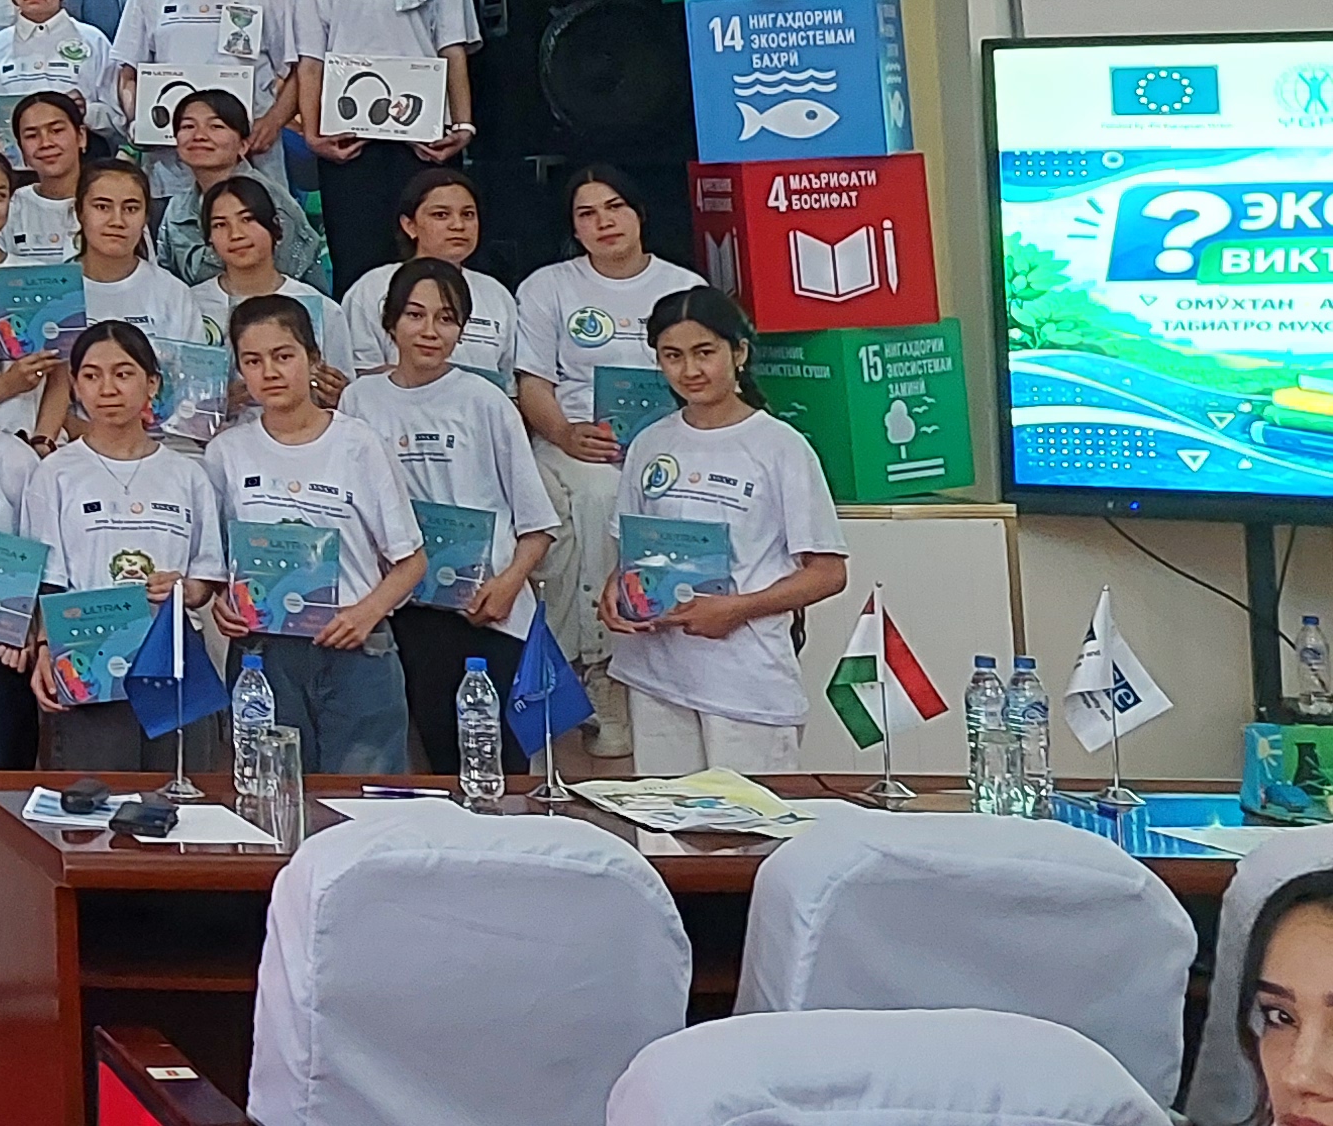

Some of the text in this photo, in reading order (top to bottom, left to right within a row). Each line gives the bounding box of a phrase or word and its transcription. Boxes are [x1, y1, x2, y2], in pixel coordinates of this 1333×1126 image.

[708, 15, 744, 53] 14
[750, 28, 856, 50] ЭКОСИСТЕМАИ
[767, 175, 788, 213] 4
[789, 170, 877, 190] МАЪРИФАТИ
[791, 191, 858, 211] БОСИФАТ
[1239, 191, 1333, 231] ЭК
[858, 344, 883, 383] 15
